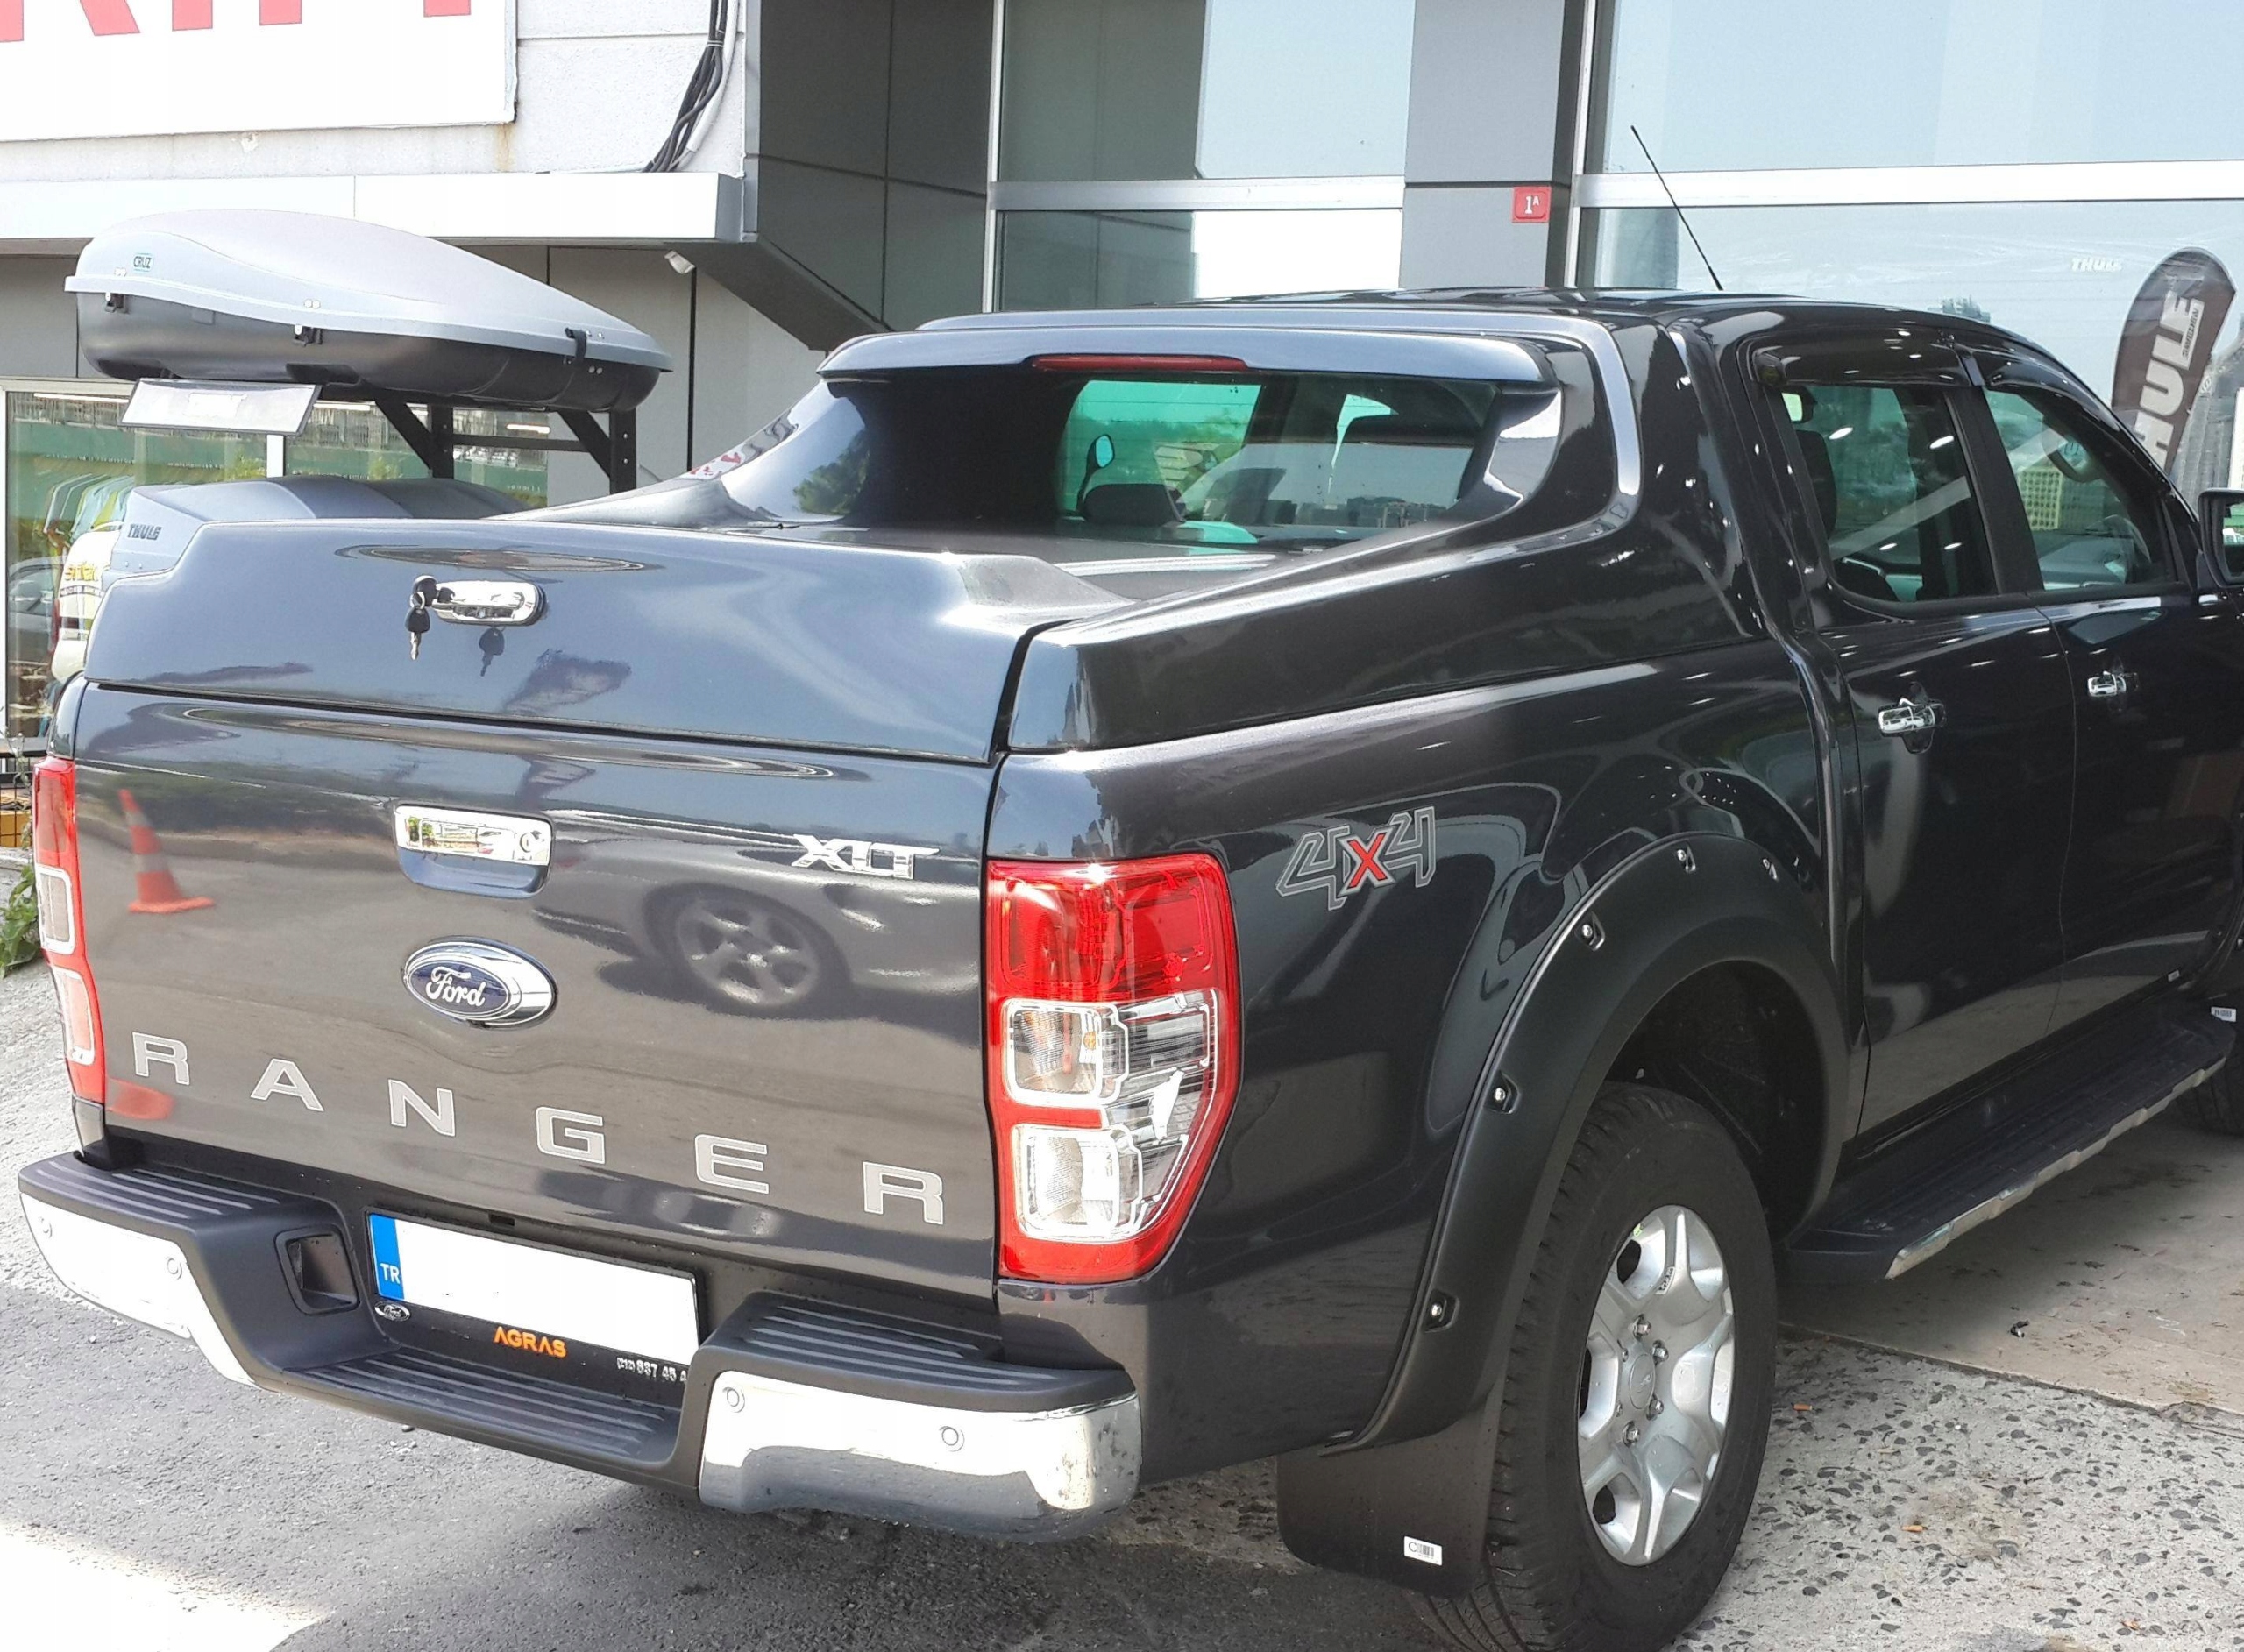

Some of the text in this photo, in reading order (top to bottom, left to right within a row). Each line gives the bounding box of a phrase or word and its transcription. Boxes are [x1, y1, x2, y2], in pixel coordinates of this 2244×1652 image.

[2134, 290, 2205, 471] HULE
[127, 523, 162, 541] THULE
[791, 833, 940, 880] XLT
[426, 966, 486, 1007] Ford
[132, 1032, 943, 1225] RANGER
[380, 1262, 401, 1284] TR
[494, 1326, 566, 1358] AGRAS
